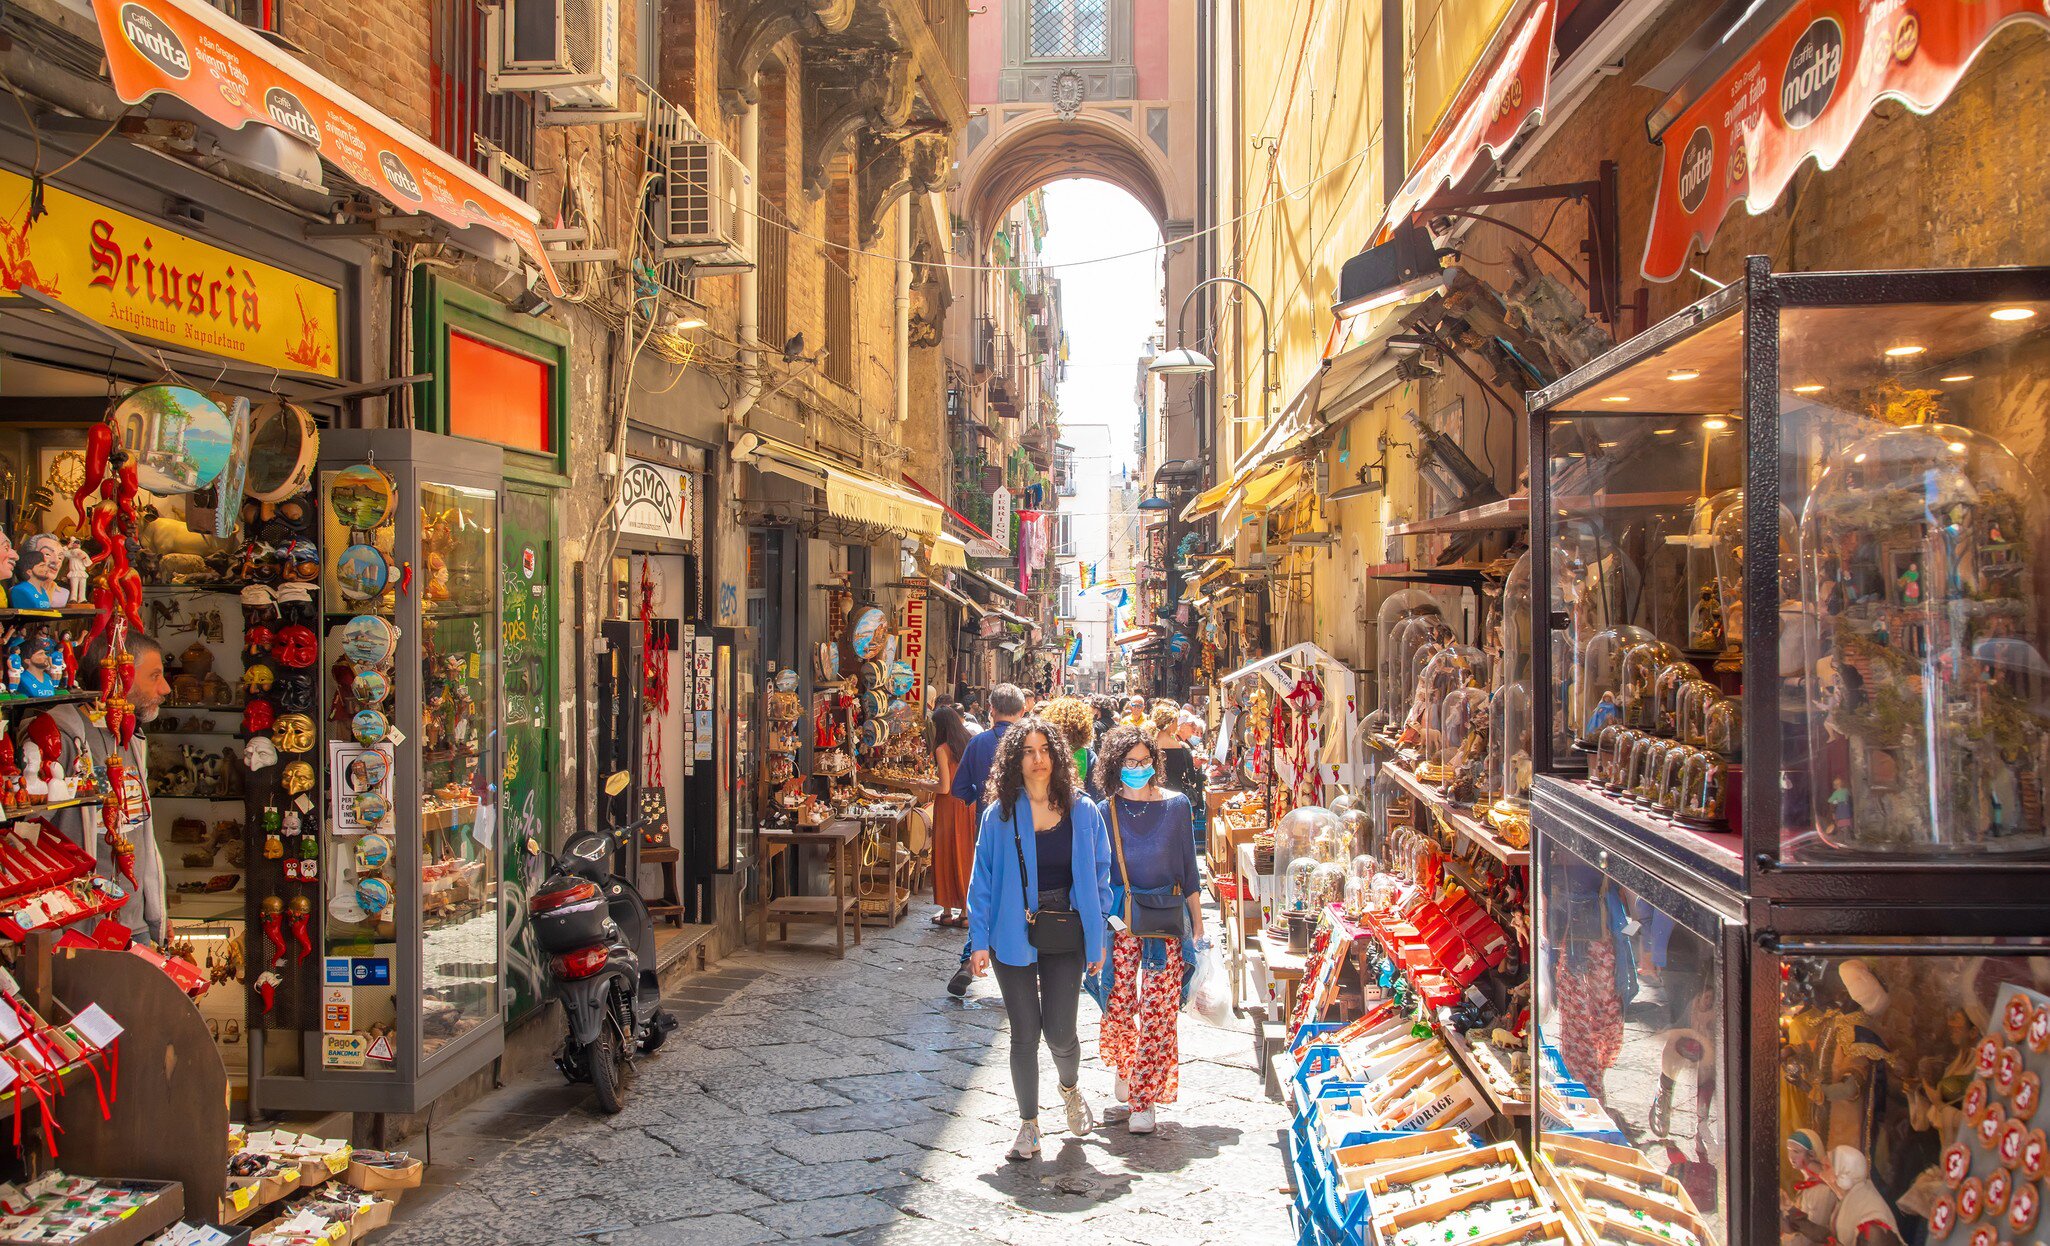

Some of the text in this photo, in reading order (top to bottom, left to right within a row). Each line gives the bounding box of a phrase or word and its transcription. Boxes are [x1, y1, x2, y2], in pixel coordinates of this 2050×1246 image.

[126, 20, 190, 71] motta
[203, 36, 215, 51] San
[216, 43, 240, 65] Gregorio
[1793, 42, 1813, 70] caffè
[228, 61, 250, 87] fatto
[1749, 76, 1767, 106] fatto
[1783, 42, 1841, 115] motta
[274, 95, 292, 110] caffè
[269, 104, 321, 142] motta
[383, 165, 420, 197] motta
[1680, 149, 1713, 201] motta
[89, 218, 262, 333] Sciuscià
[108, 301, 246, 352] Artigianato Napoletano
[622, 468, 673, 524] OSMOS
[996, 493, 1006, 540] FERRIGNO
[328, 1036, 350, 1050] Pago
[1402, 1094, 1455, 1132] STORAGE
